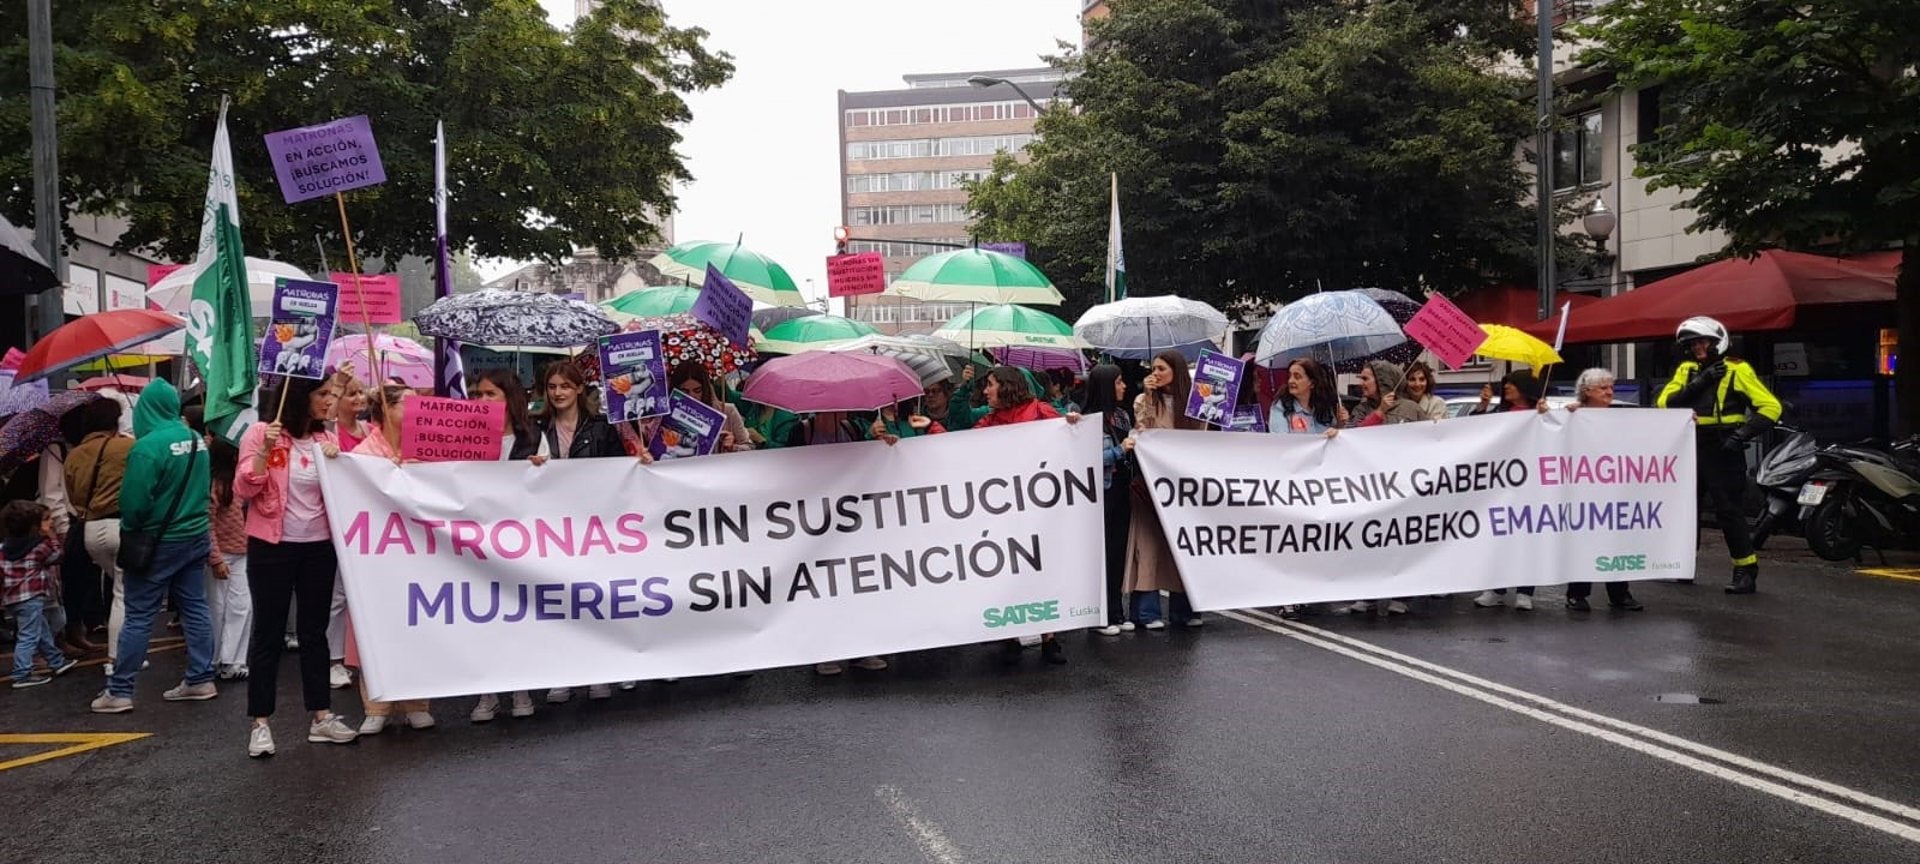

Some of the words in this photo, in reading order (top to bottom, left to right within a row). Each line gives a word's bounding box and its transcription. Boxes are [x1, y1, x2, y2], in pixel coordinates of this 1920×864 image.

[282, 122, 355, 145] MATRONAS
[285, 151, 303, 163] EN
[306, 137, 362, 158] ACCIÓN,
[290, 154, 368, 181] ¡BUSCAMOS
[298, 170, 370, 194] SOLUCIÓN!
[420, 401, 490, 415] MATRONAS
[416, 416, 433, 426] EN
[436, 417, 491, 431] ACCIÓN,
[414, 432, 491, 446] ¡BUSCAMOS
[415, 446, 488, 460] SOLUCIÓN!
[1154, 471, 1406, 508] ORDEZKAPENIK
[1410, 458, 1528, 497] GABEKO
[1538, 455, 1678, 486] EMAGINAK
[664, 504, 750, 549] SIN
[766, 461, 1098, 540] SUSTITUCIÓN
[1177, 520, 1354, 556] ARRETARIK
[1362, 509, 1481, 548] GABEKO
[1488, 501, 1663, 537] EMAKUMEAK
[1595, 554, 1646, 572] SATSE
[408, 576, 673, 626] MUJERES
[689, 566, 772, 612] SIN
[787, 530, 1043, 601] ATENCIÓN
[983, 600, 1060, 628] SATSE
